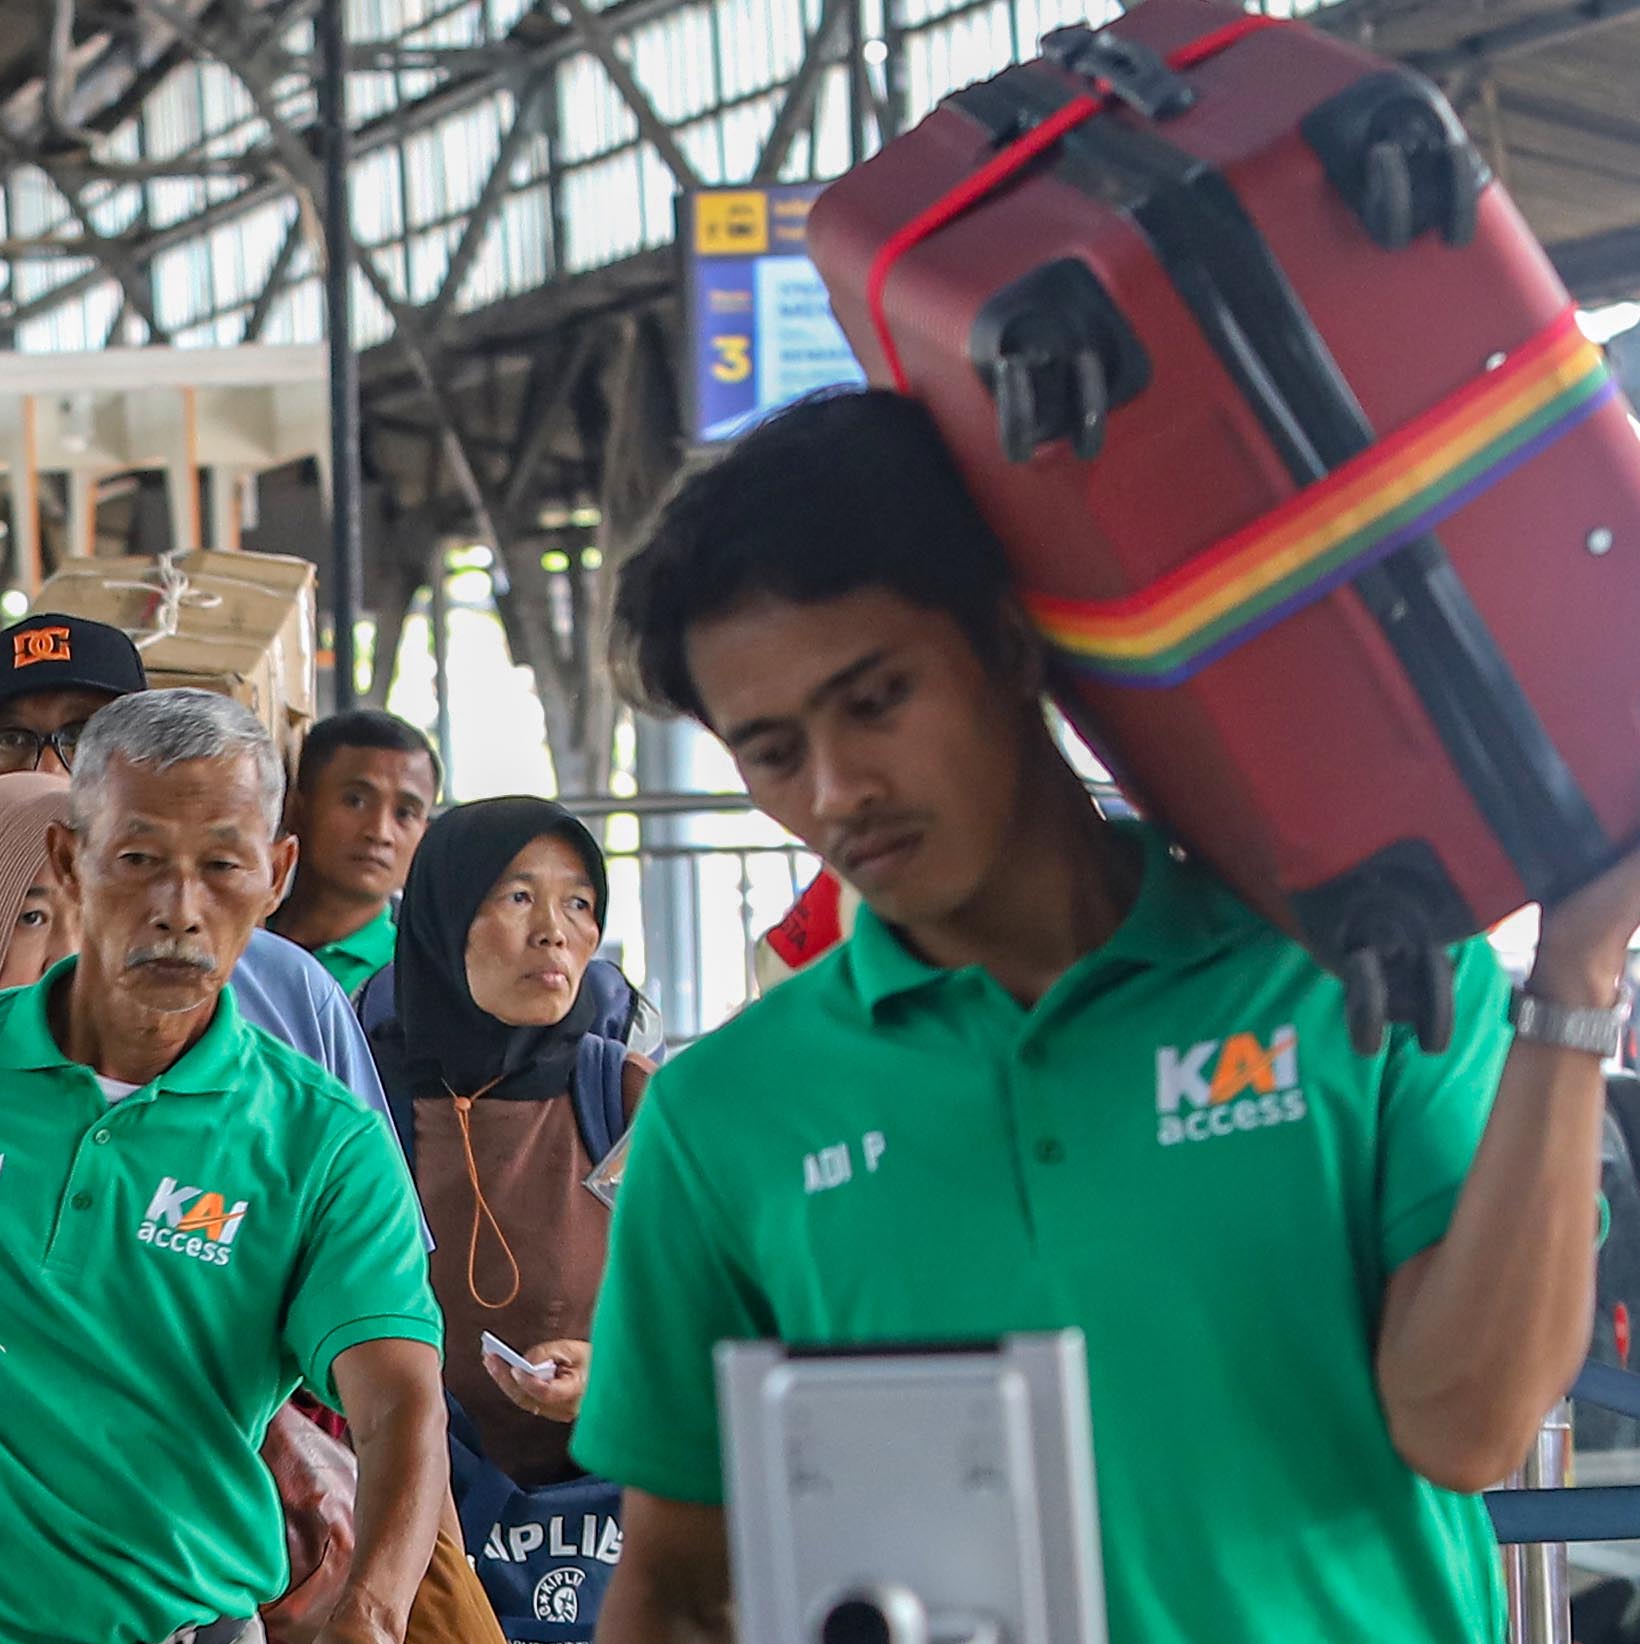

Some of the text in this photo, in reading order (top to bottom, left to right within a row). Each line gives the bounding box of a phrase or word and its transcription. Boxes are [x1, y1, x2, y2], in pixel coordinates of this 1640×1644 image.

[711, 332, 753, 384] 3
[1155, 1024, 1298, 1115] KAI
[1157, 1088, 1307, 1146] access
[862, 1130, 886, 1173] P
[145, 1176, 249, 1245] KAI
[137, 1220, 233, 1266] access
